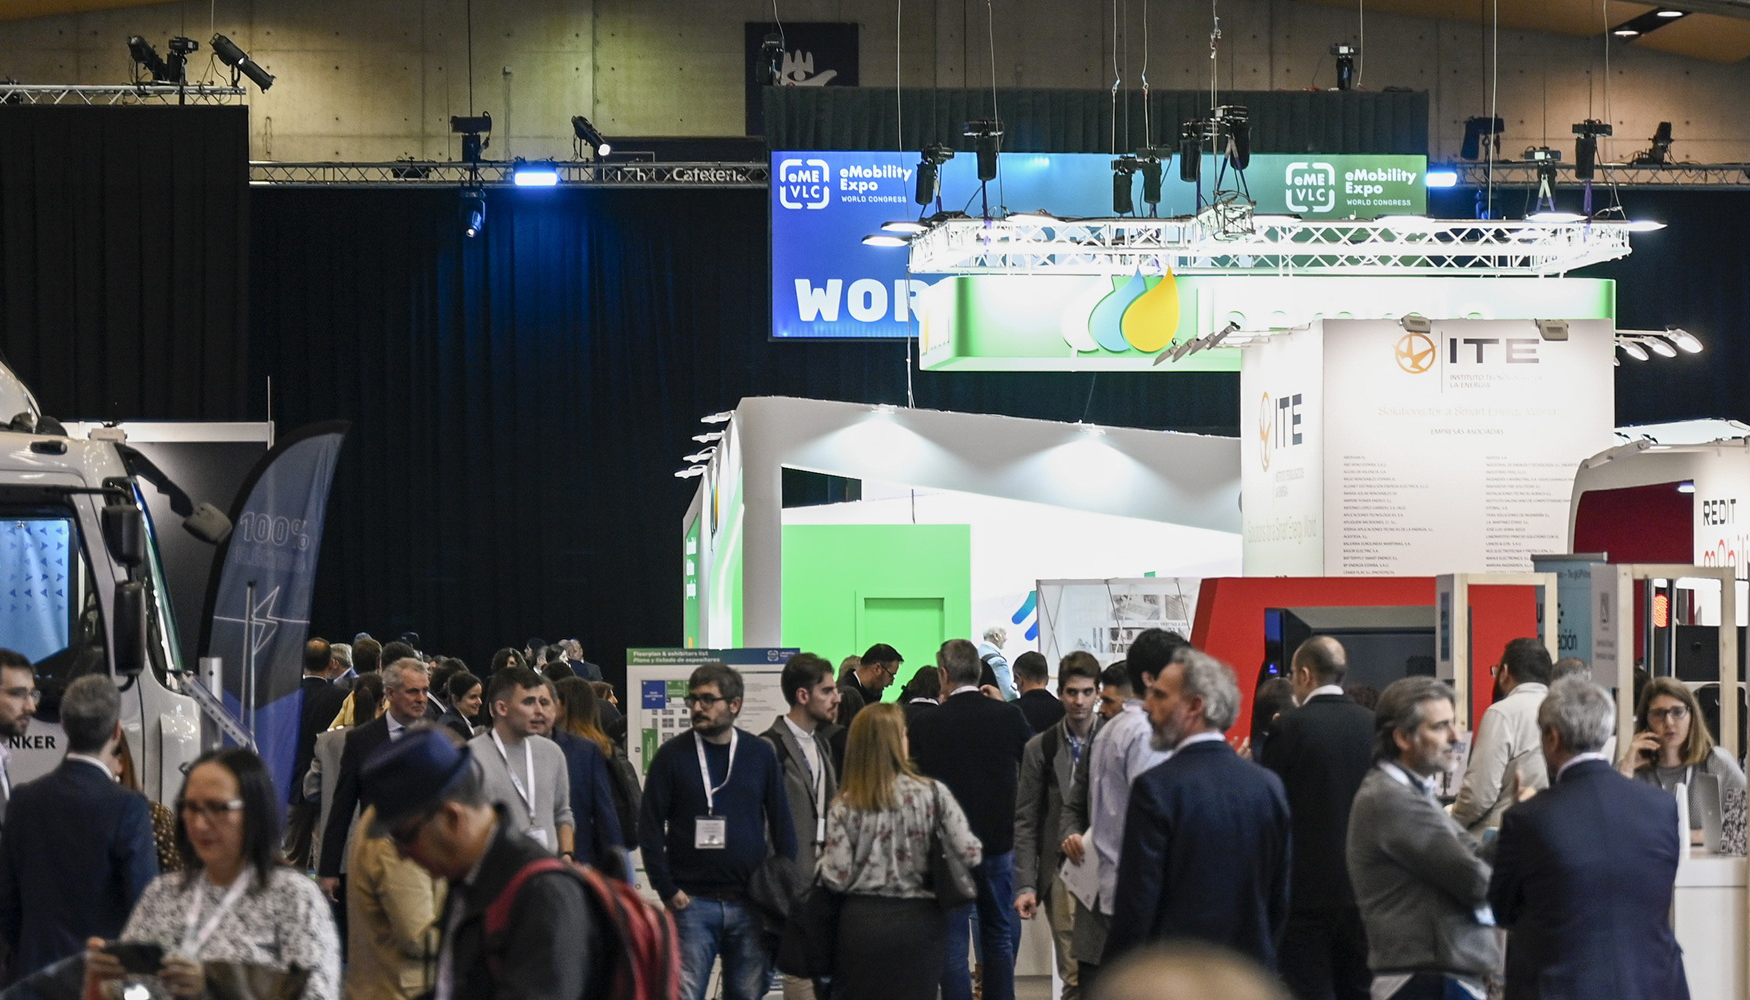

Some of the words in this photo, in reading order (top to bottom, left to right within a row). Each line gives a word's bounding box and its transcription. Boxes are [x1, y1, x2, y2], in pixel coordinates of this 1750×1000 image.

[788, 170, 820, 183] eME
[840, 164, 912, 182] eMobility
[1294, 174, 1325, 186] eME
[1345, 168, 1417, 185] eMobility
[791, 185, 820, 198] VLC
[840, 179, 879, 194] Expo
[1296, 188, 1326, 201] VLC
[1345, 182, 1384, 197] Expo
[1450, 338, 1540, 364] ITE
[1275, 393, 1303, 450] ITE
[1703, 498, 1737, 526] REDIT
[240, 511, 310, 552] 100%
